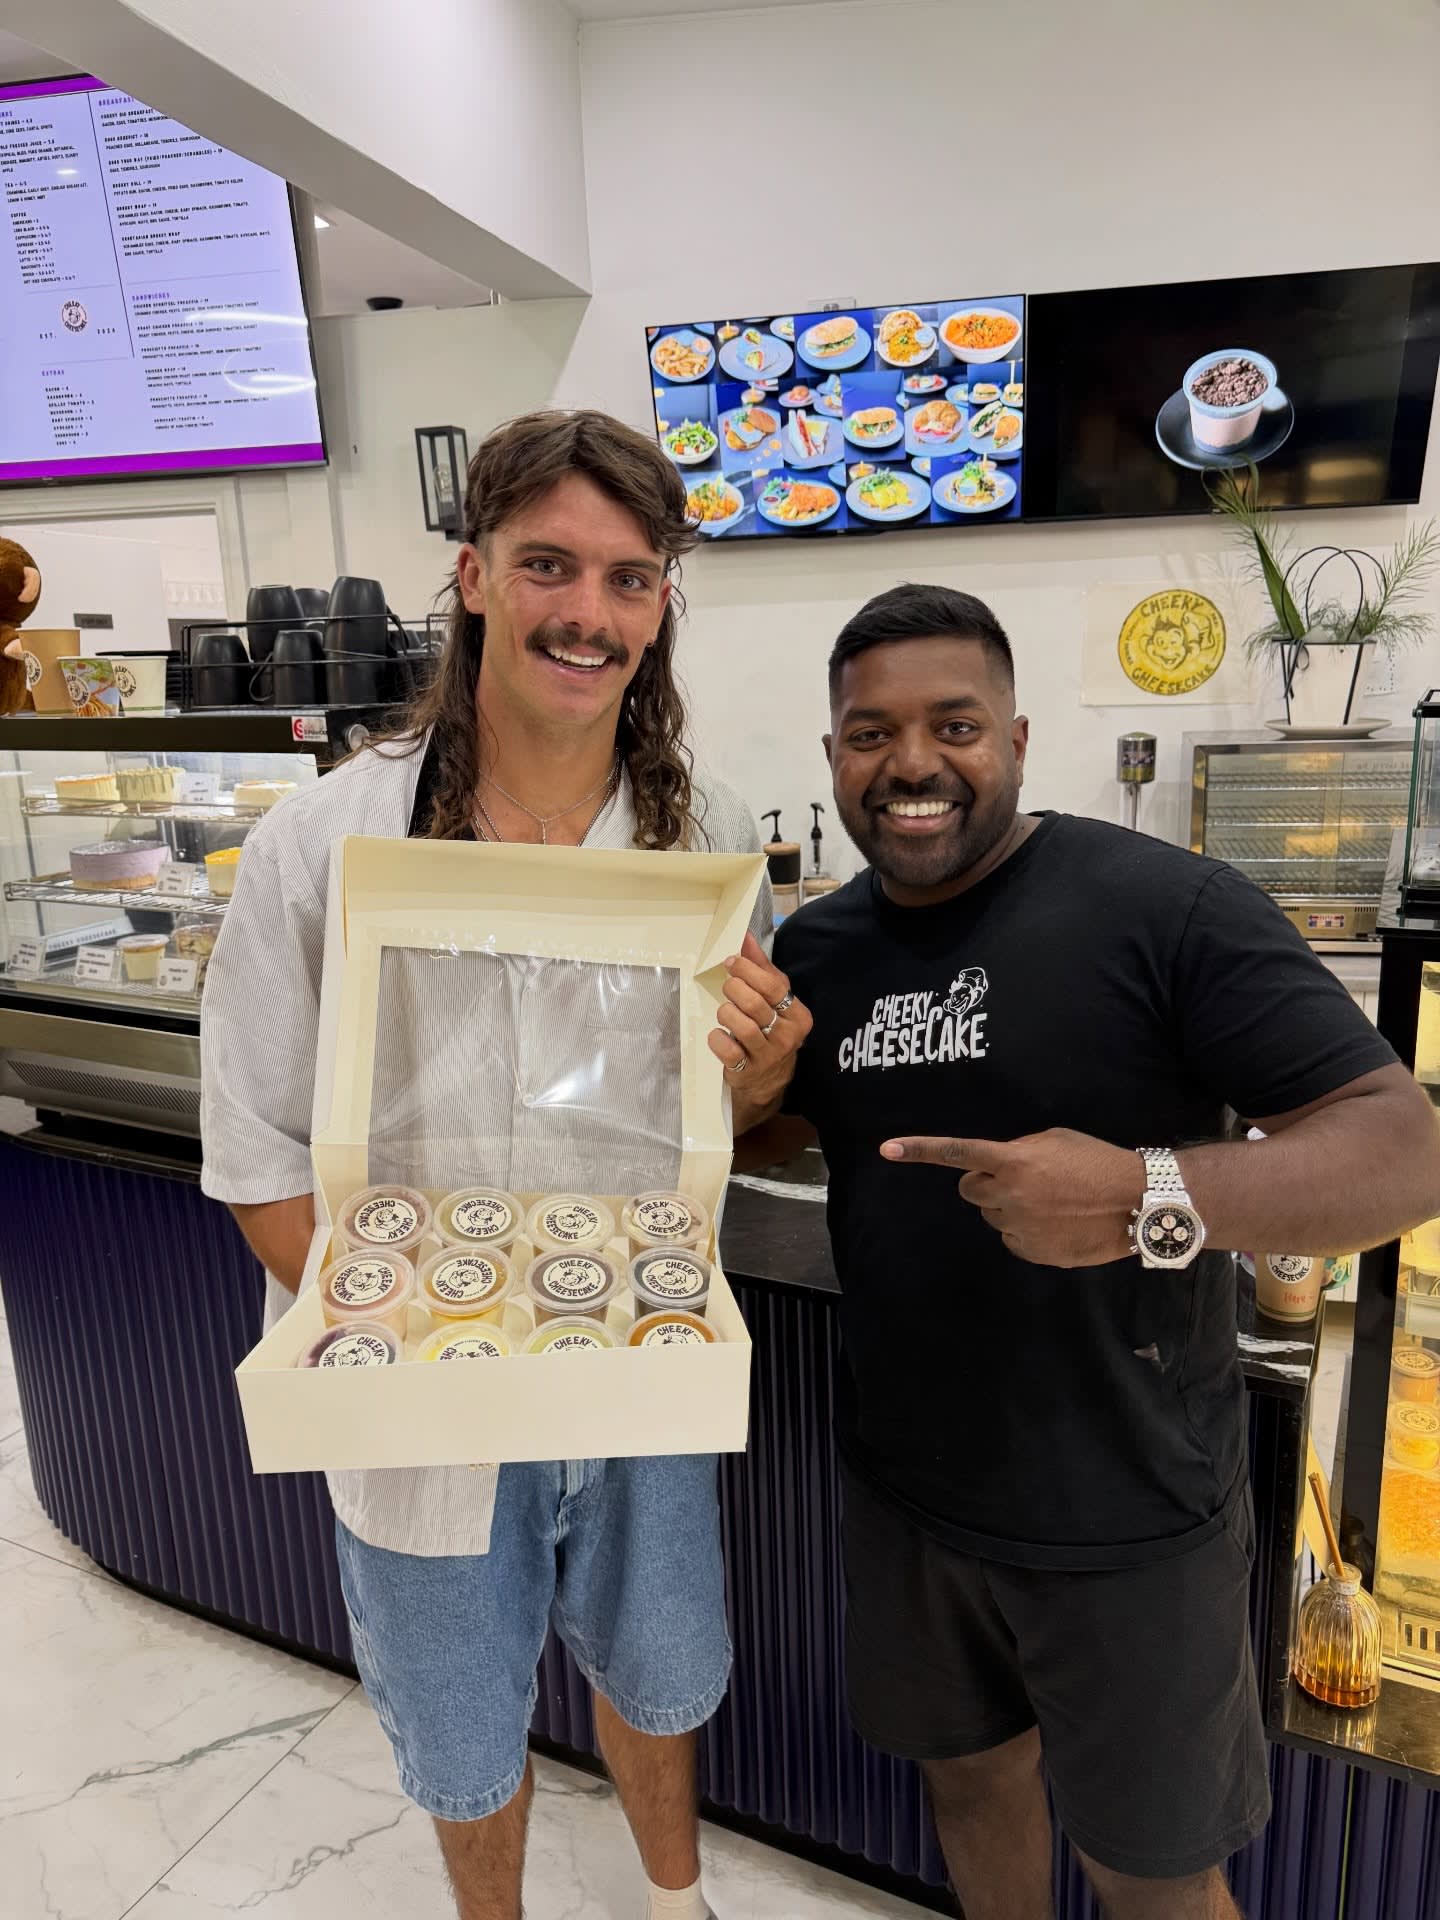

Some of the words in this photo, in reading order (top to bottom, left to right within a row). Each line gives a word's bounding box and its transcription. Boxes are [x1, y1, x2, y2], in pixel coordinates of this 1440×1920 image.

[1140, 594, 1204, 617] CHEEKY
[872, 990, 934, 1029] CHEEKY
[838, 1004, 989, 1073] CHEESECAKE
[358, 1200, 396, 1229] CHEESECAKE
[458, 1199, 505, 1214] CHEESECAKE
[573, 1206, 598, 1224] CHEEKY
[640, 1201, 670, 1214] CHEEKY
[387, 1217, 413, 1240] CHEEKY
[464, 1224, 499, 1235] CHEEKY
[648, 1216, 689, 1233] CHEESECAKE
[456, 1259, 492, 1284] CHEESECAKE
[558, 1259, 594, 1270] CHEEKY
[665, 1261, 698, 1276] CHEEKY
[1271, 1264, 1310, 1282] CHEESECAKE
[377, 1266, 393, 1293] CHEEKY
[435, 1279, 464, 1298] CHEEKY
[548, 1280, 599, 1297] CHEESECAKE
[645, 1273, 689, 1295] CHEESECAKE
[656, 1324, 694, 1336] CHEEKY
[356, 1336, 386, 1357] CHEEKY
[554, 1335, 592, 1350] CHEEKY
